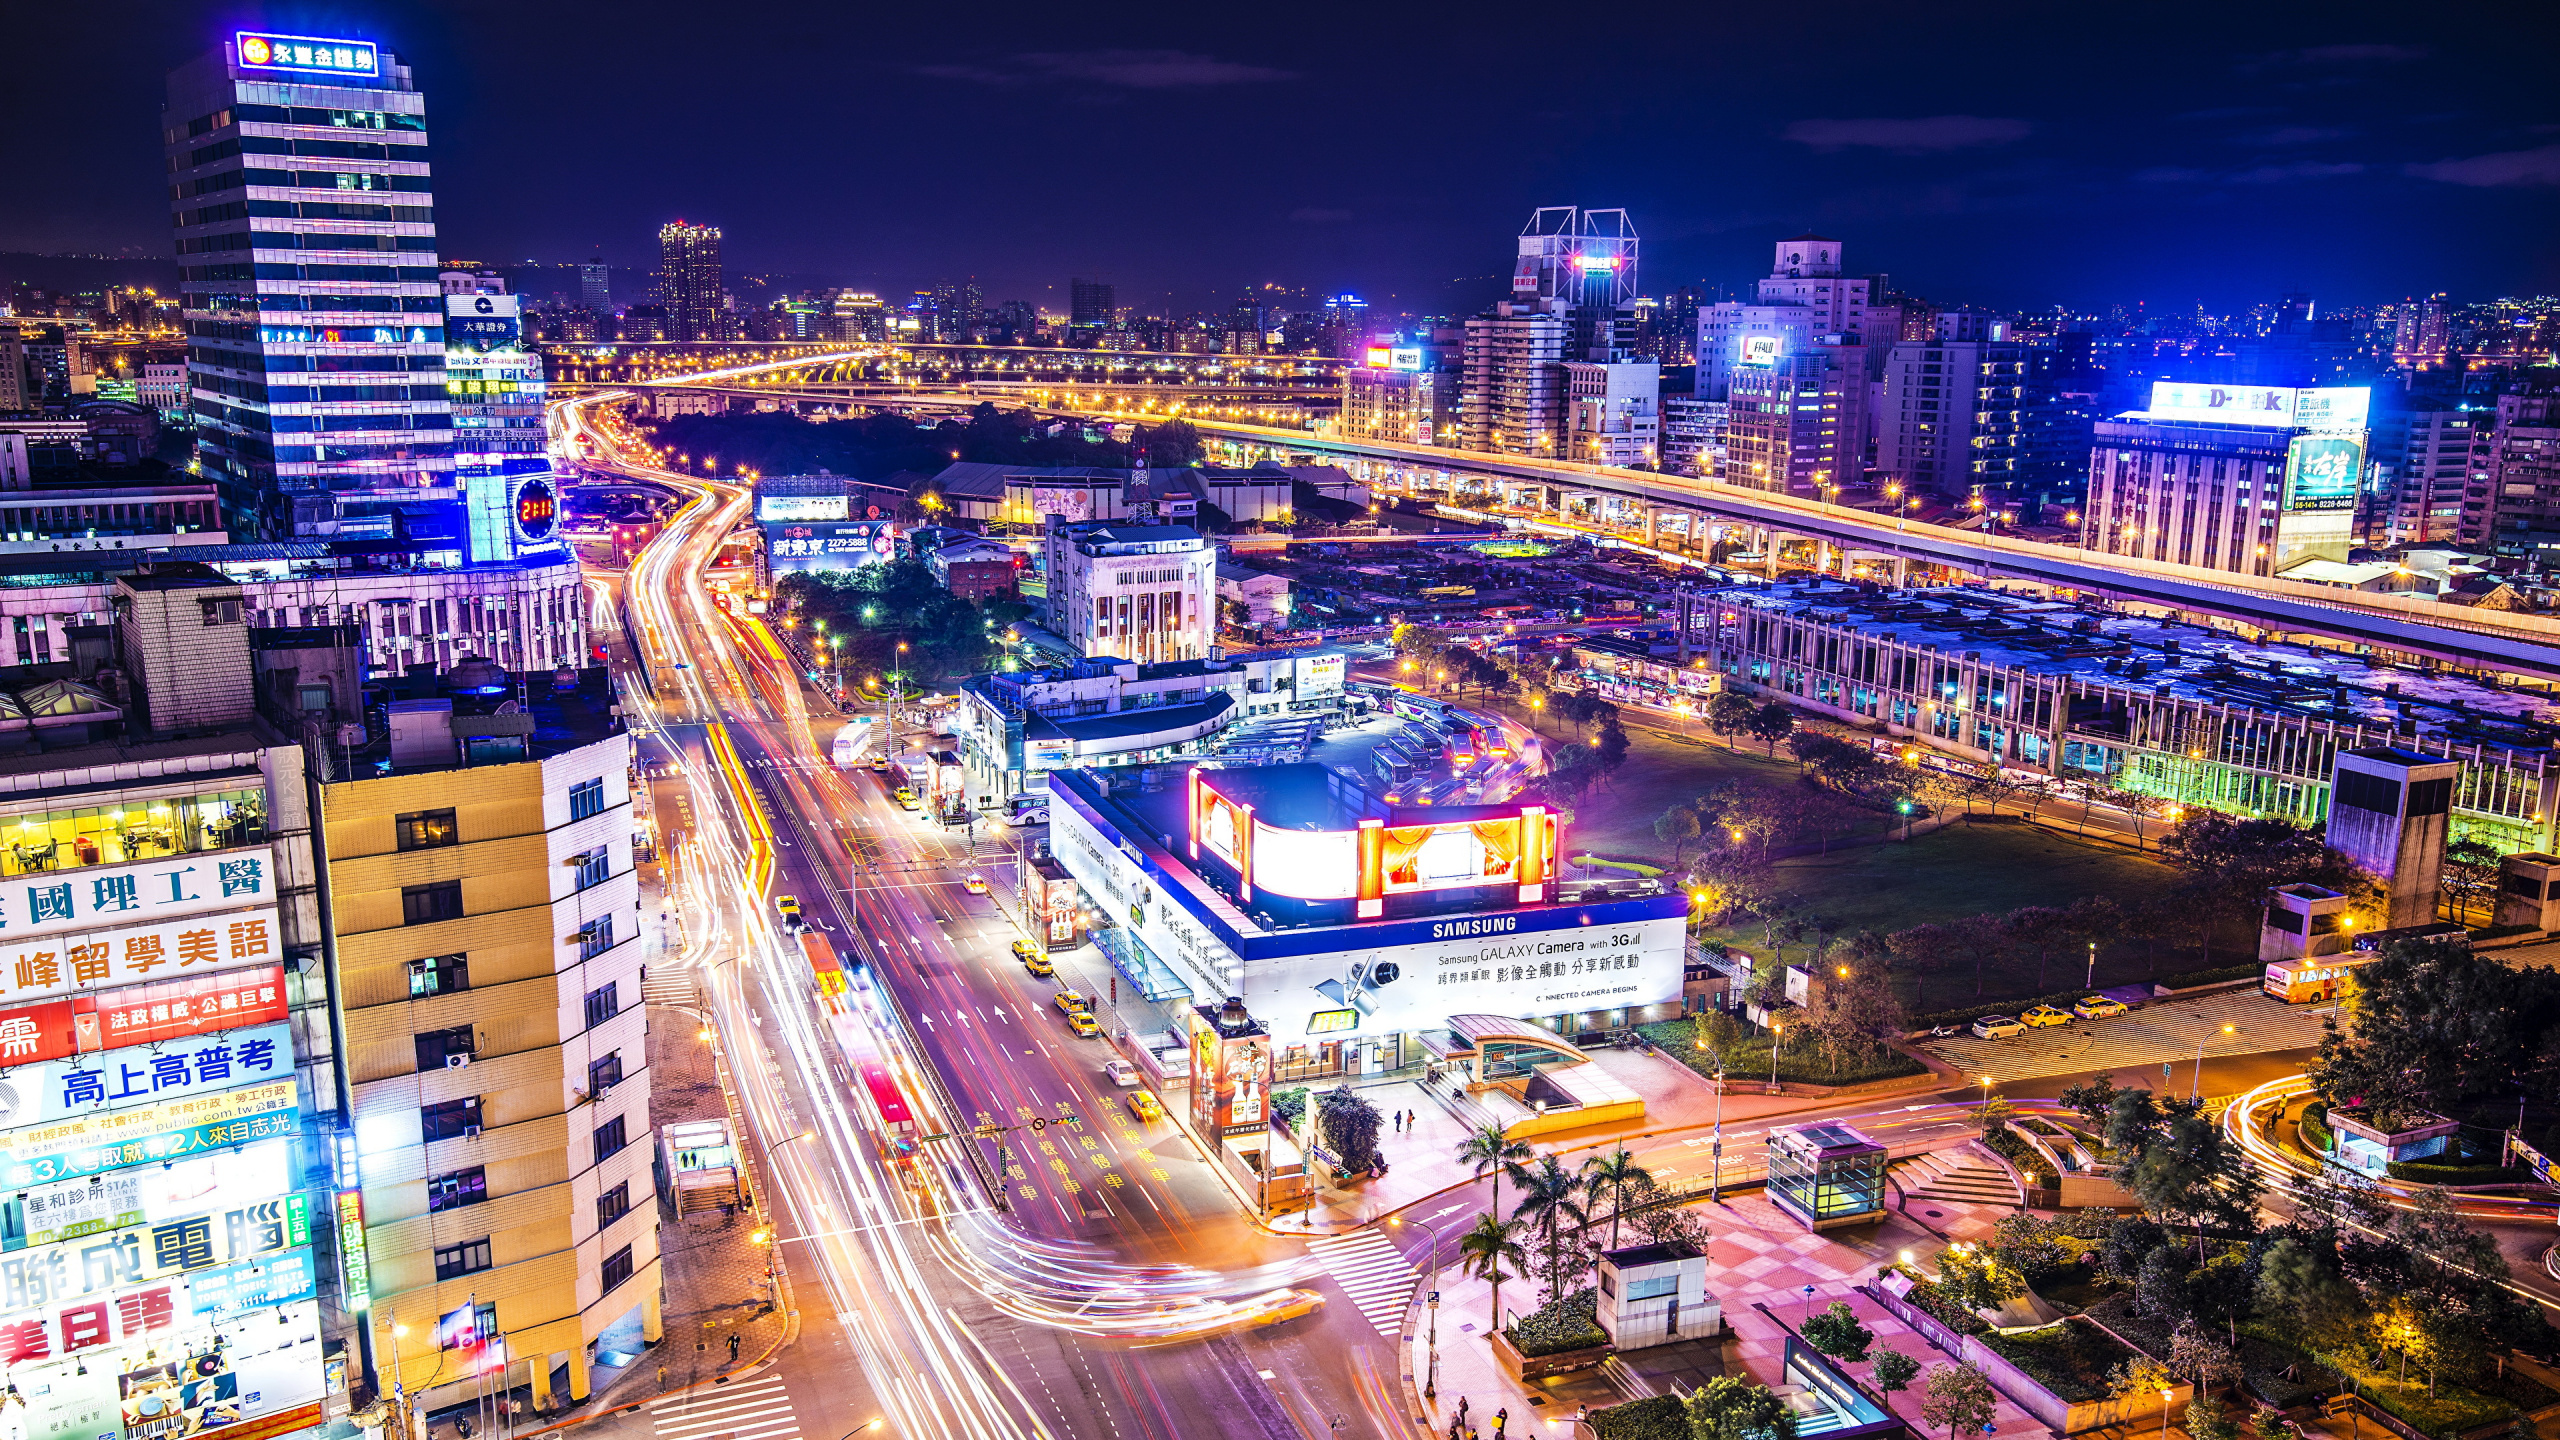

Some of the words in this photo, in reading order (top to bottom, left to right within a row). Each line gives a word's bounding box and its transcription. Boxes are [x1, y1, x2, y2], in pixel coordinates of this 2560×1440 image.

[273, 44, 373, 69] 永豐金證券
[464, 322, 506, 332] 大華證券
[773, 539, 825, 556] 新東京
[278, 748, 301, 828] 狀元K書館
[1120, 835, 1143, 866] SAMSUNG
[0, 857, 262, 929] 國理工醫
[1433, 916, 1516, 938] SAMSUNG
[0, 919, 269, 994] 峰留學美語
[1438, 953, 1478, 966] Samsung
[1481, 944, 1534, 961] GALAXY
[1537, 940, 1585, 955] Camera
[1589, 940, 1608, 949] with
[1611, 934, 1629, 947] 3G
[1437, 969, 1490, 985] 跨界類單眼
[1496, 961, 1566, 983] 影像全觸動
[1571, 953, 1640, 975] 分享新感動
[1535, 990, 1579, 1002] CNNECTED
[1581, 987, 1611, 998] CAMERA
[1612, 985, 1638, 994] BEGINS
[62, 1038, 276, 1108] 高上高普考
[256, 1098, 288, 1112] 公職王
[29, 1184, 104, 1214] 星和診所
[107, 1178, 138, 1192] STAR
[107, 1187, 139, 1198] CLINIC
[1, 1201, 283, 1308] 聯成電腦
[236, 1279, 267, 1293] TOEIC
[273, 1270, 305, 1285] IELTS
[289, 1279, 311, 1295] 4F
